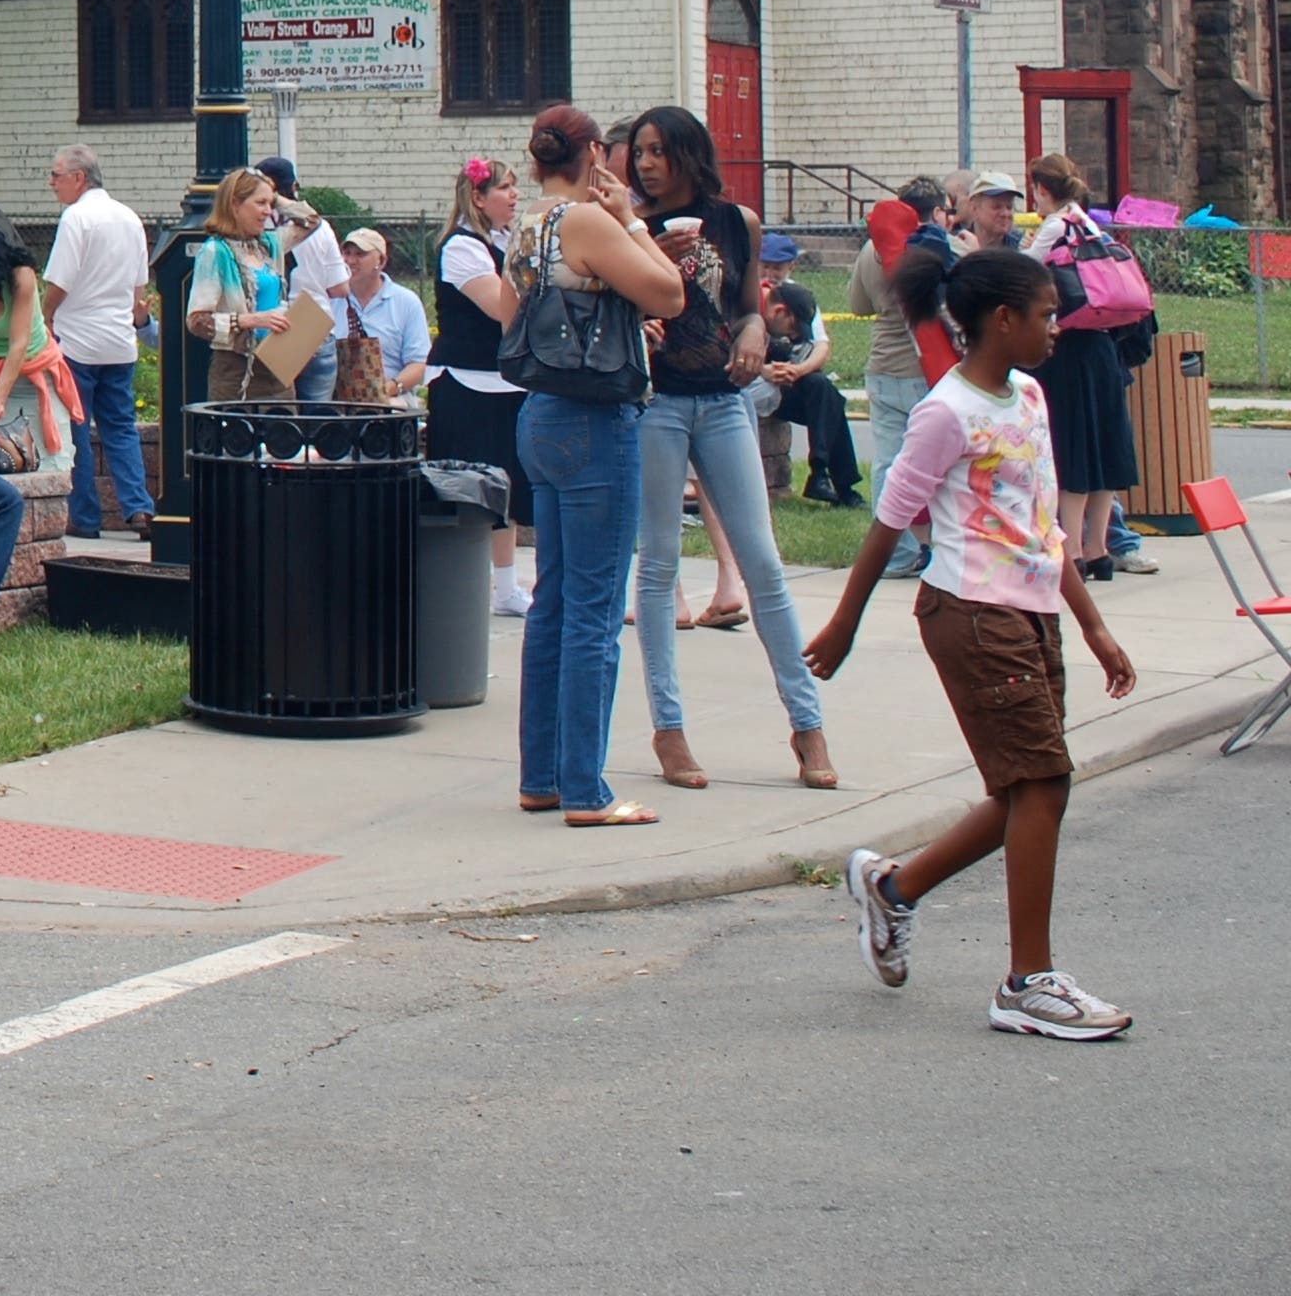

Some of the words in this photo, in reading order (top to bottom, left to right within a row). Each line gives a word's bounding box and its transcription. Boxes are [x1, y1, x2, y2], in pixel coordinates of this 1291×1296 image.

[272, 9, 318, 19] LIBERTY
[322, 7, 368, 17] CENTER
[246, 21, 276, 40] Valley
[277, 21, 308, 37] Street
[313, 20, 349, 39] Orange
[356, 18, 373, 35] NJ
[243, 49, 262, 57] DAY:
